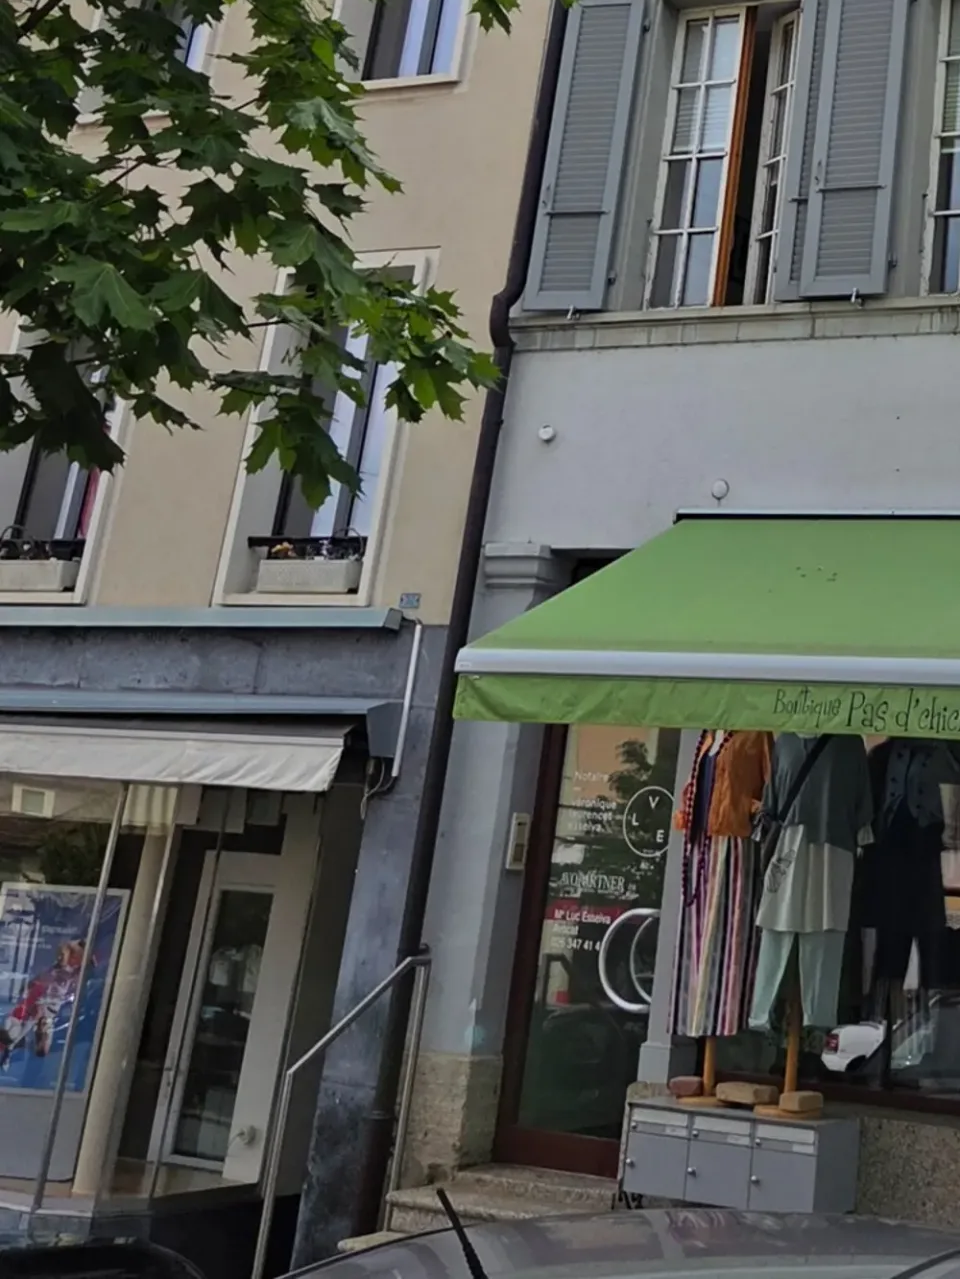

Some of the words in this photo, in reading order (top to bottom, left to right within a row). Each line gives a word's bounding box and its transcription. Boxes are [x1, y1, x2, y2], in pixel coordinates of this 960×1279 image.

[773, 686, 841, 728] Boutique
[846, 691, 889, 732] Pas
[656, 830, 665, 843] E
[567, 938, 582, 950] 347
